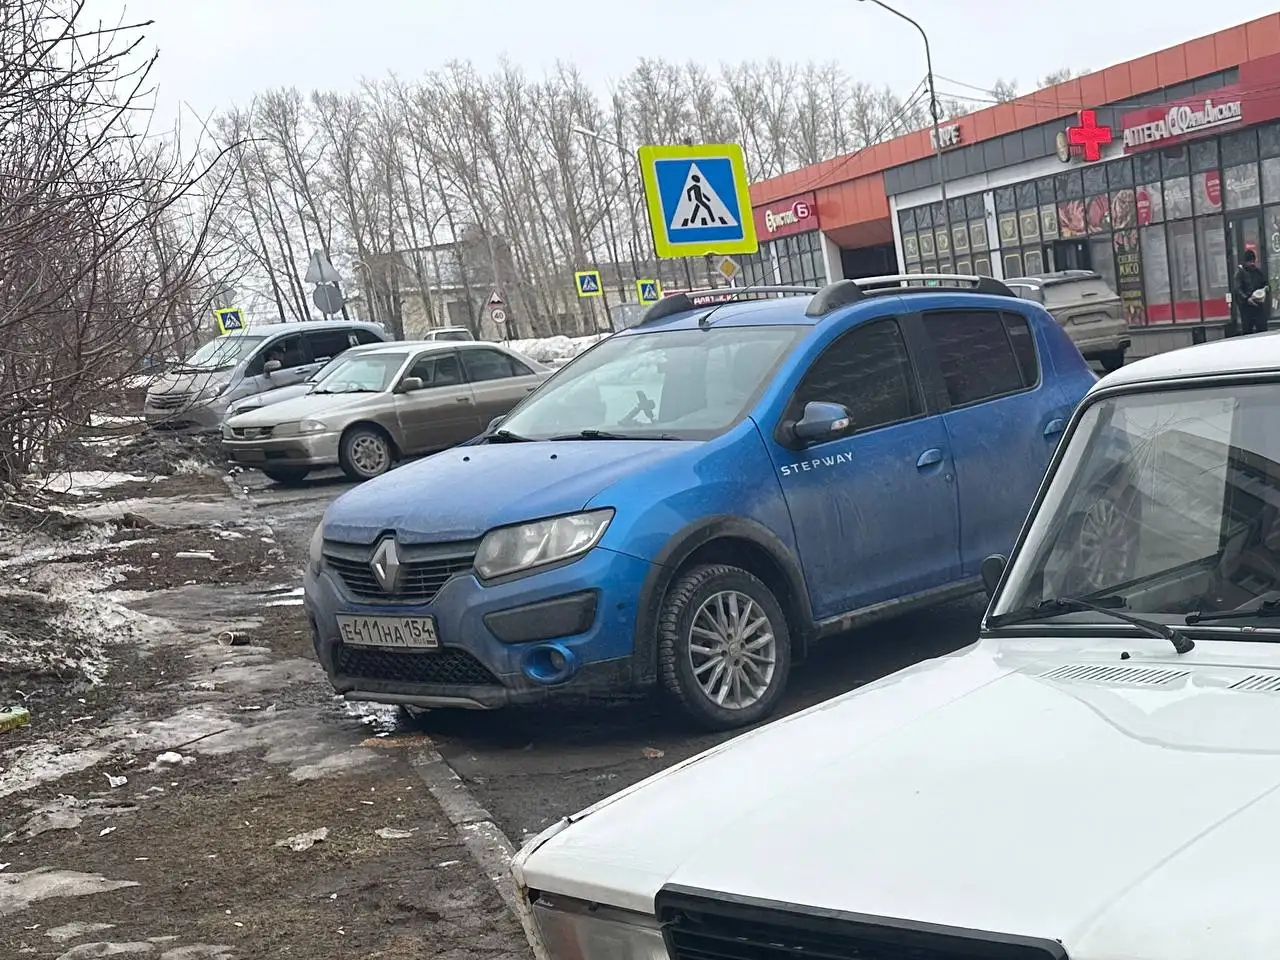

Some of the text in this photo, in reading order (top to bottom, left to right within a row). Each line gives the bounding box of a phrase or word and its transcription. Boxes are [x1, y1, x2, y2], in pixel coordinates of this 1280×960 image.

[1123, 118, 1168, 147] АПТЕКА
[494, 311, 504, 319] 40
[780, 452, 853, 476] STEPWAY
